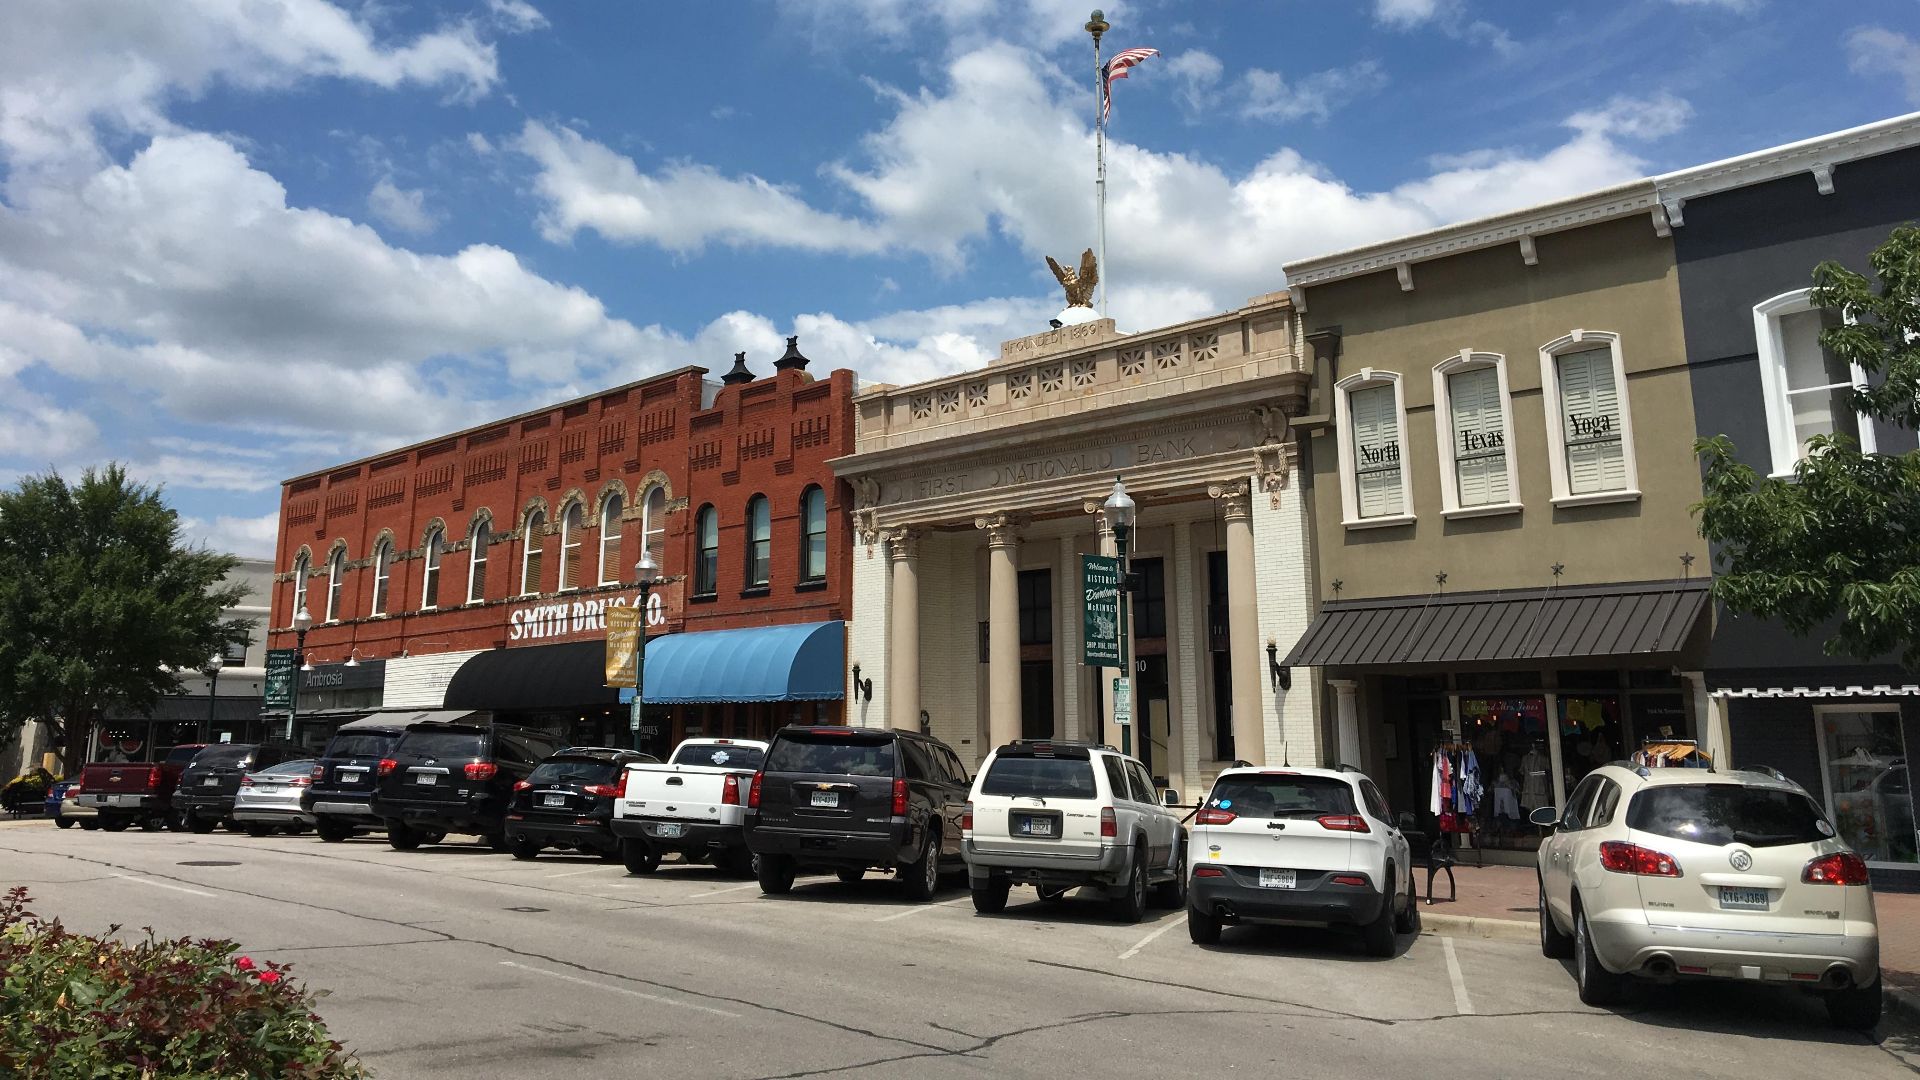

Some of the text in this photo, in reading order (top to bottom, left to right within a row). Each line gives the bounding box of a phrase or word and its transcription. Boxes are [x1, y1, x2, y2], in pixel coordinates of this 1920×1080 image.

[1009, 324, 1096, 353] FOUNDED 1869
[1360, 413, 1611, 465] North Texas Yoga
[919, 437, 1196, 497] FIRST NATIONAL BANK
[1087, 574, 1117, 585] HISTORIC
[1087, 602, 1117, 613] McKINNEY
[511, 602, 569, 640] SMITH
[306, 669, 343, 687] Ambrosia
[1114, 680, 1120, 690] 3
[1267, 822, 1286, 831] Jeep
